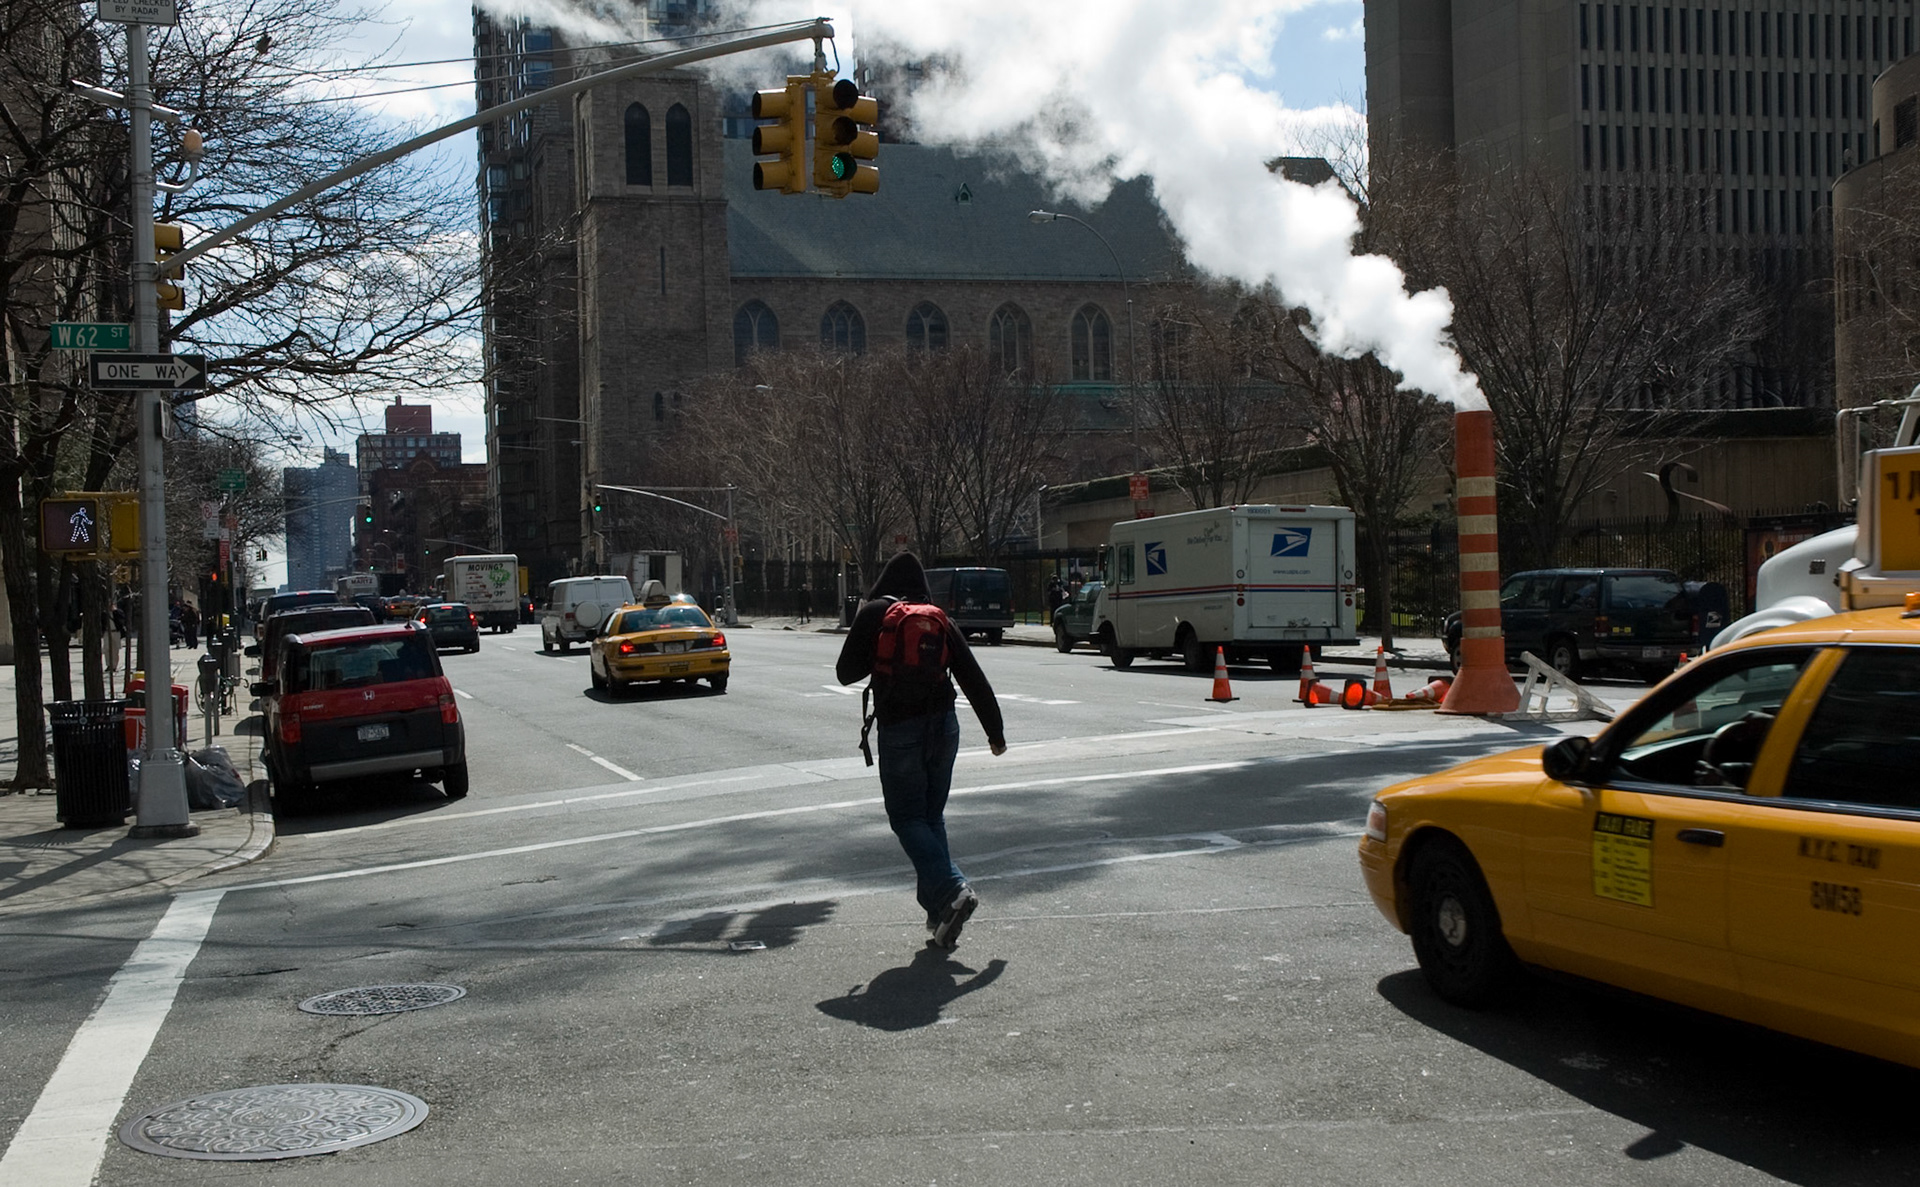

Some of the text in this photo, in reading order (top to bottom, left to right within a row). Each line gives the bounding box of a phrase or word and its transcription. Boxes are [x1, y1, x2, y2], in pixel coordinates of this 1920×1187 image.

[115, 5, 159, 15] BY RADAR
[58, 326, 125, 347] W 62 ST
[107, 364, 189, 379] ONE WAY
[467, 562, 504, 571] MOVING?
[1597, 814, 1623, 833] TAXI
[1847, 843, 1882, 869] TAXI
